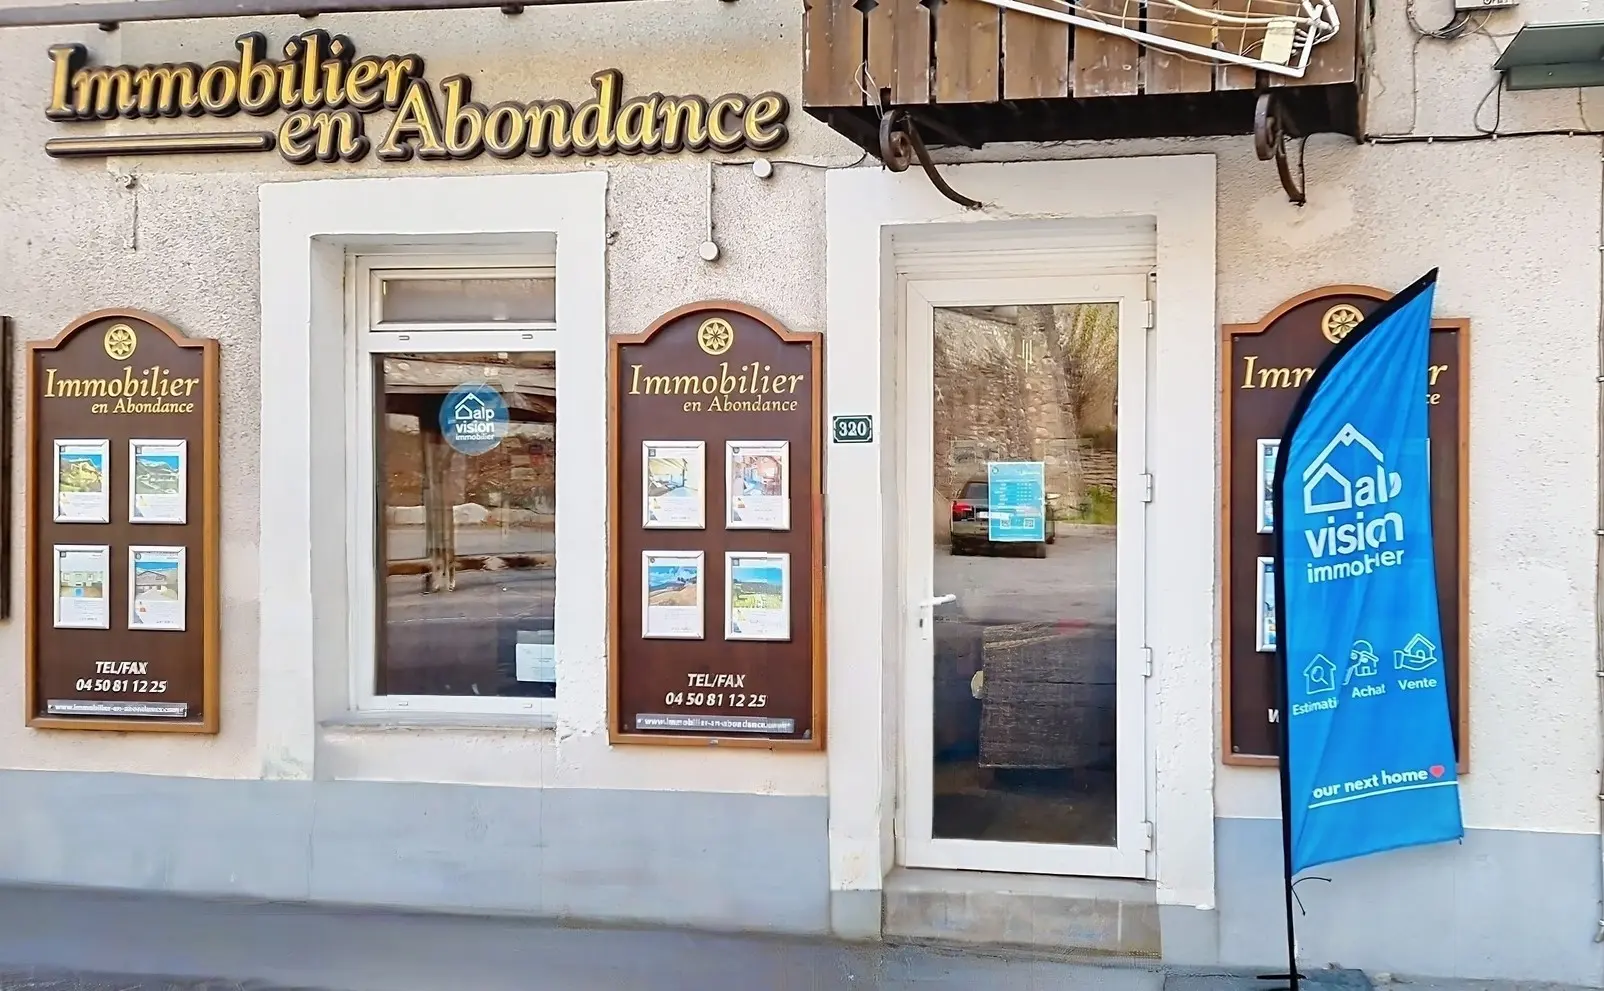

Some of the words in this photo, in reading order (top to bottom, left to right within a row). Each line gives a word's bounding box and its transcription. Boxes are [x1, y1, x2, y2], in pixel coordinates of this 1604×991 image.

[46, 30, 423, 121] Immobilier
[278, 109, 369, 164] en
[377, 69, 790, 161] Abondance
[44, 365, 200, 398] Immobilier
[628, 362, 804, 395] Immobilier
[91, 403, 109, 414] en
[112, 397, 194, 414] Abondance
[683, 401, 701, 412] en
[707, 395, 798, 412] Abondance
[473, 407, 495, 421] alp
[455, 420, 495, 434] vision
[839, 421, 867, 437] 320
[1304, 511, 1404, 558] vision
[95, 661, 149, 675] TEL/FAX
[75, 678, 92, 691] 04
[94, 678, 111, 692] 50
[112, 679, 128, 692] 81
[132, 680, 150, 693] 12
[149, 680, 168, 694] 25
[687, 673, 746, 688] TEL/FAX
[1398, 677, 1438, 691] Vente
[1351, 684, 1386, 699] Achat
[665, 692, 682, 706] 04
[685, 692, 704, 706] 50
[706, 693, 724, 707] 81
[728, 693, 745, 707] 12
[747, 694, 768, 708] 25
[1292, 697, 1339, 717] Estimati
[1344, 774, 1380, 793] next
[1381, 768, 1429, 786] home
